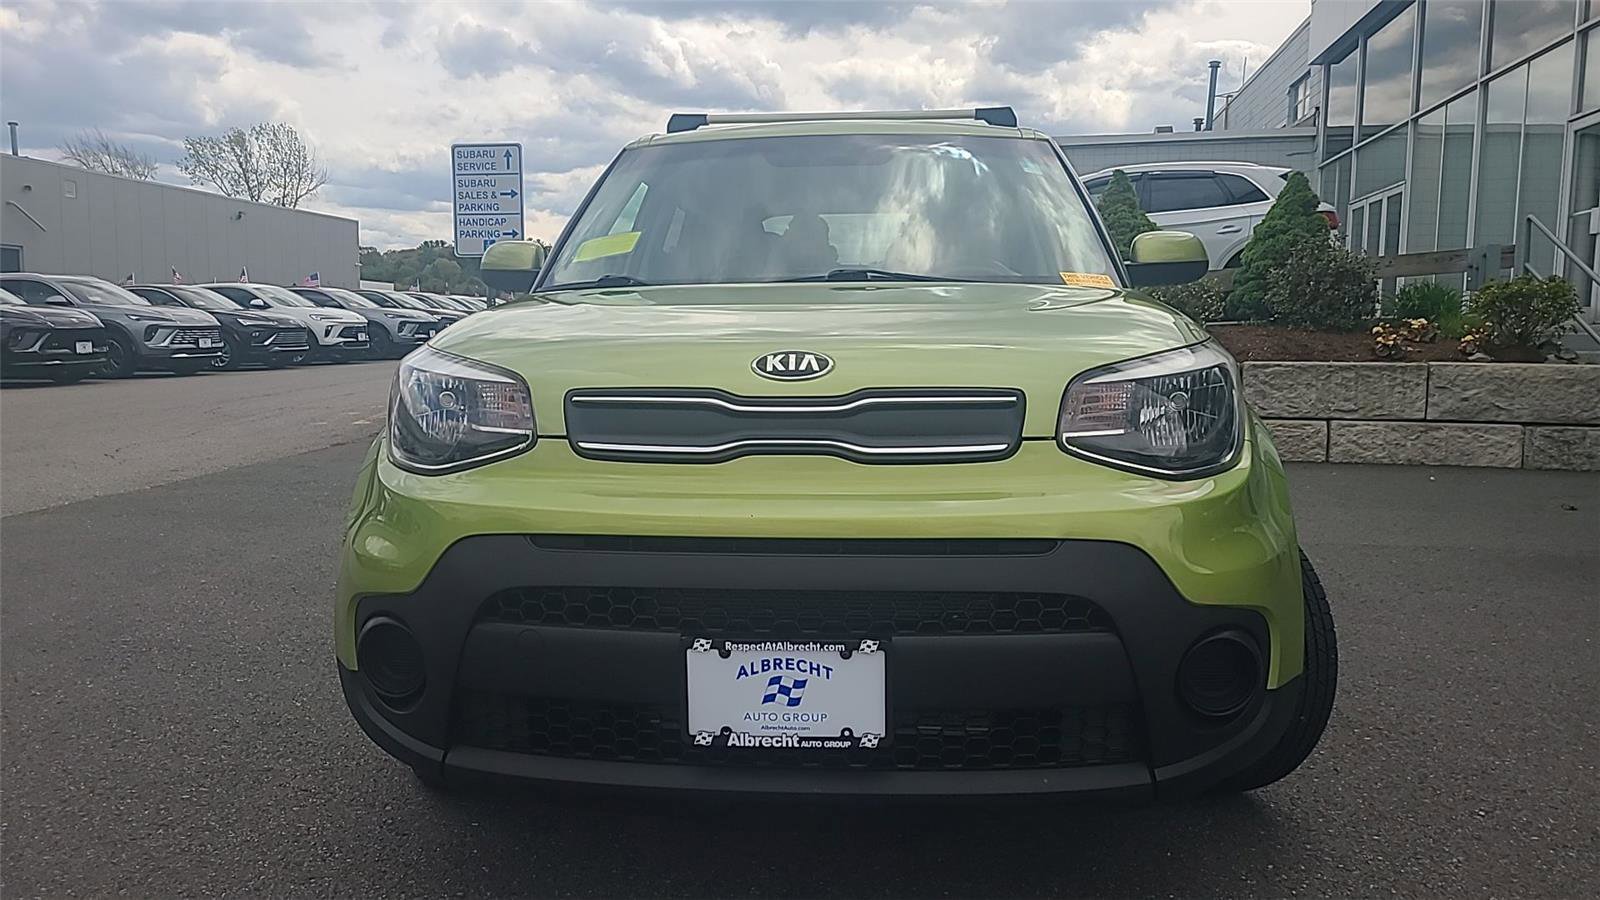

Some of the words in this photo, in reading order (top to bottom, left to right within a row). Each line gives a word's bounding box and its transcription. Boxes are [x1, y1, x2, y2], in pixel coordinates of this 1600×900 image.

[456, 150, 496, 159] SUBARU
[457, 162, 497, 171] SERVICE
[458, 179, 497, 188] SUBARU
[458, 191, 489, 200] SALES
[490, 191, 498, 200] &
[459, 203, 500, 212] PARKING
[459, 218, 507, 227] HANDICAP
[459, 230, 501, 239] PARKING
[766, 353, 820, 372] KIA
[724, 641, 846, 653] RespectAtAlbrecht.com
[735, 657, 834, 680] ALBRECHT
[743, 712, 779, 722] AUTO
[782, 712, 829, 723] GROUP
[760, 724, 811, 732] AlbrechtAuto.com
[727, 732, 800, 748] Albrecht
[824, 741, 852, 749] GROUP
